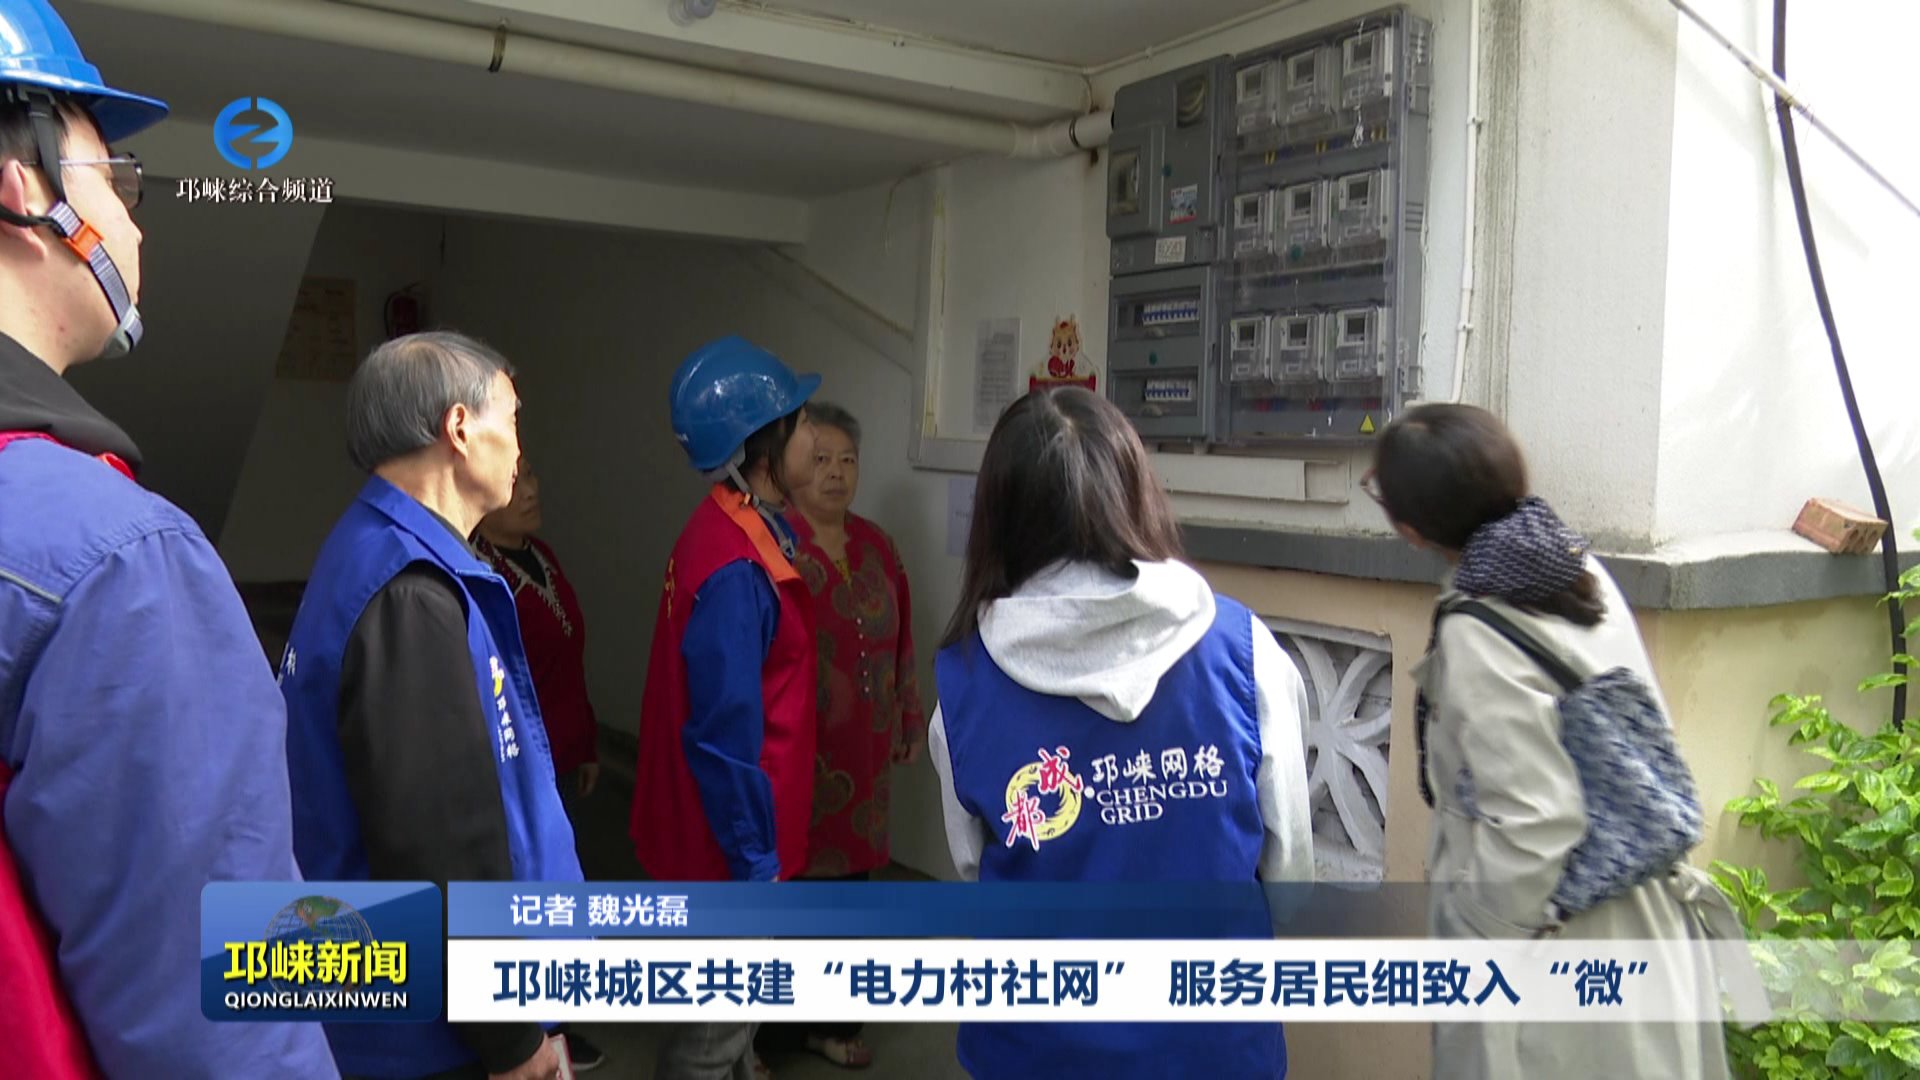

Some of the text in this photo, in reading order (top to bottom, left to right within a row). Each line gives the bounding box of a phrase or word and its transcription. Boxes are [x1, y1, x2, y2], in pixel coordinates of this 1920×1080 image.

[1091, 745, 1225, 789] 邛崃网格
[1096, 779, 1228, 808] CHENGDU
[1101, 803, 1164, 825] GRID
